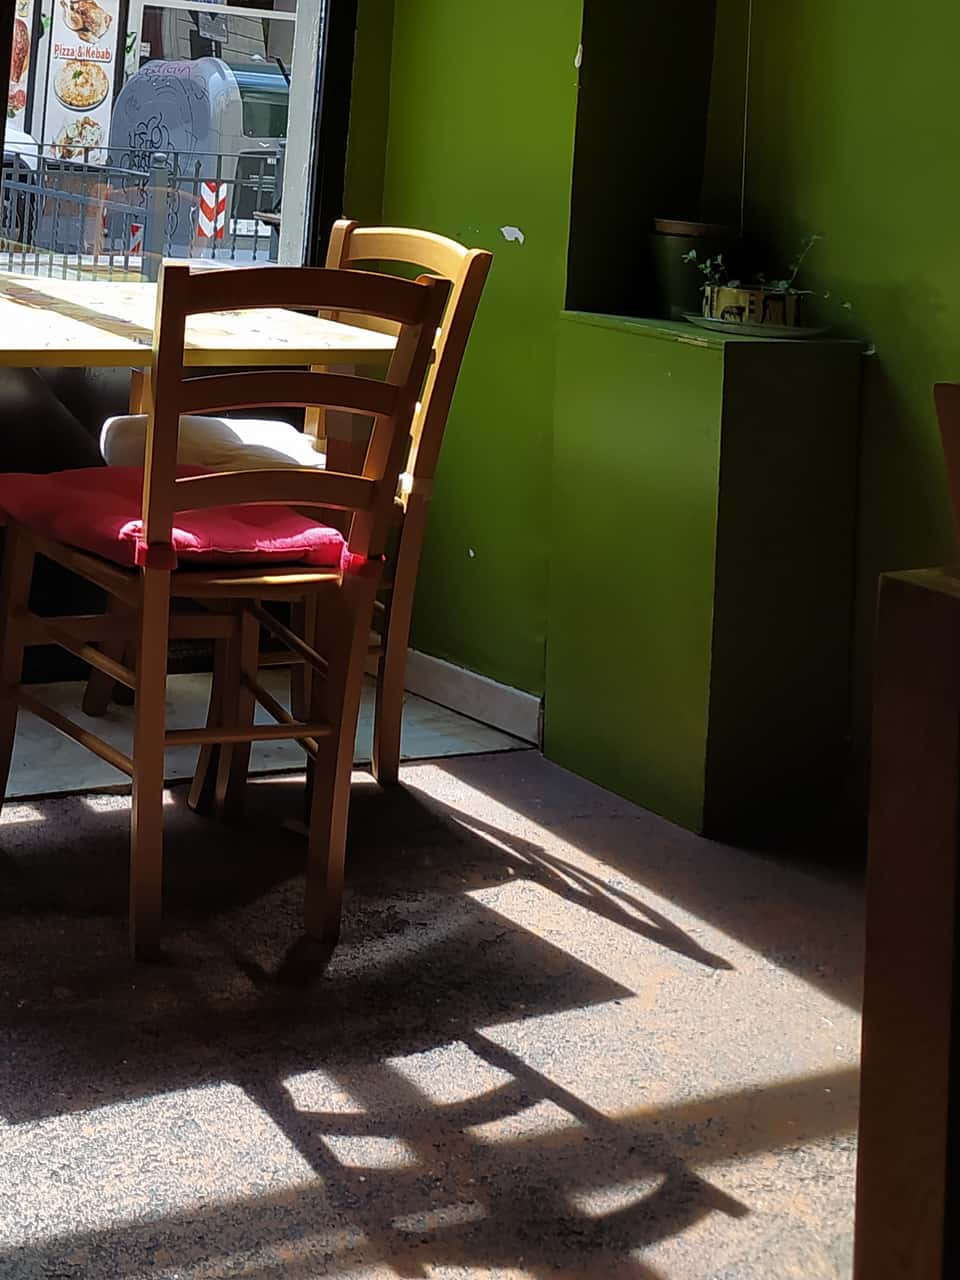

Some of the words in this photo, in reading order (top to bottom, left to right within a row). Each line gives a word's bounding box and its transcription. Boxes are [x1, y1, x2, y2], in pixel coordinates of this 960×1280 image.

[54, 43, 75, 57] Pizza
[77, 45, 83, 58] &
[85, 46, 111, 60] Kebab
